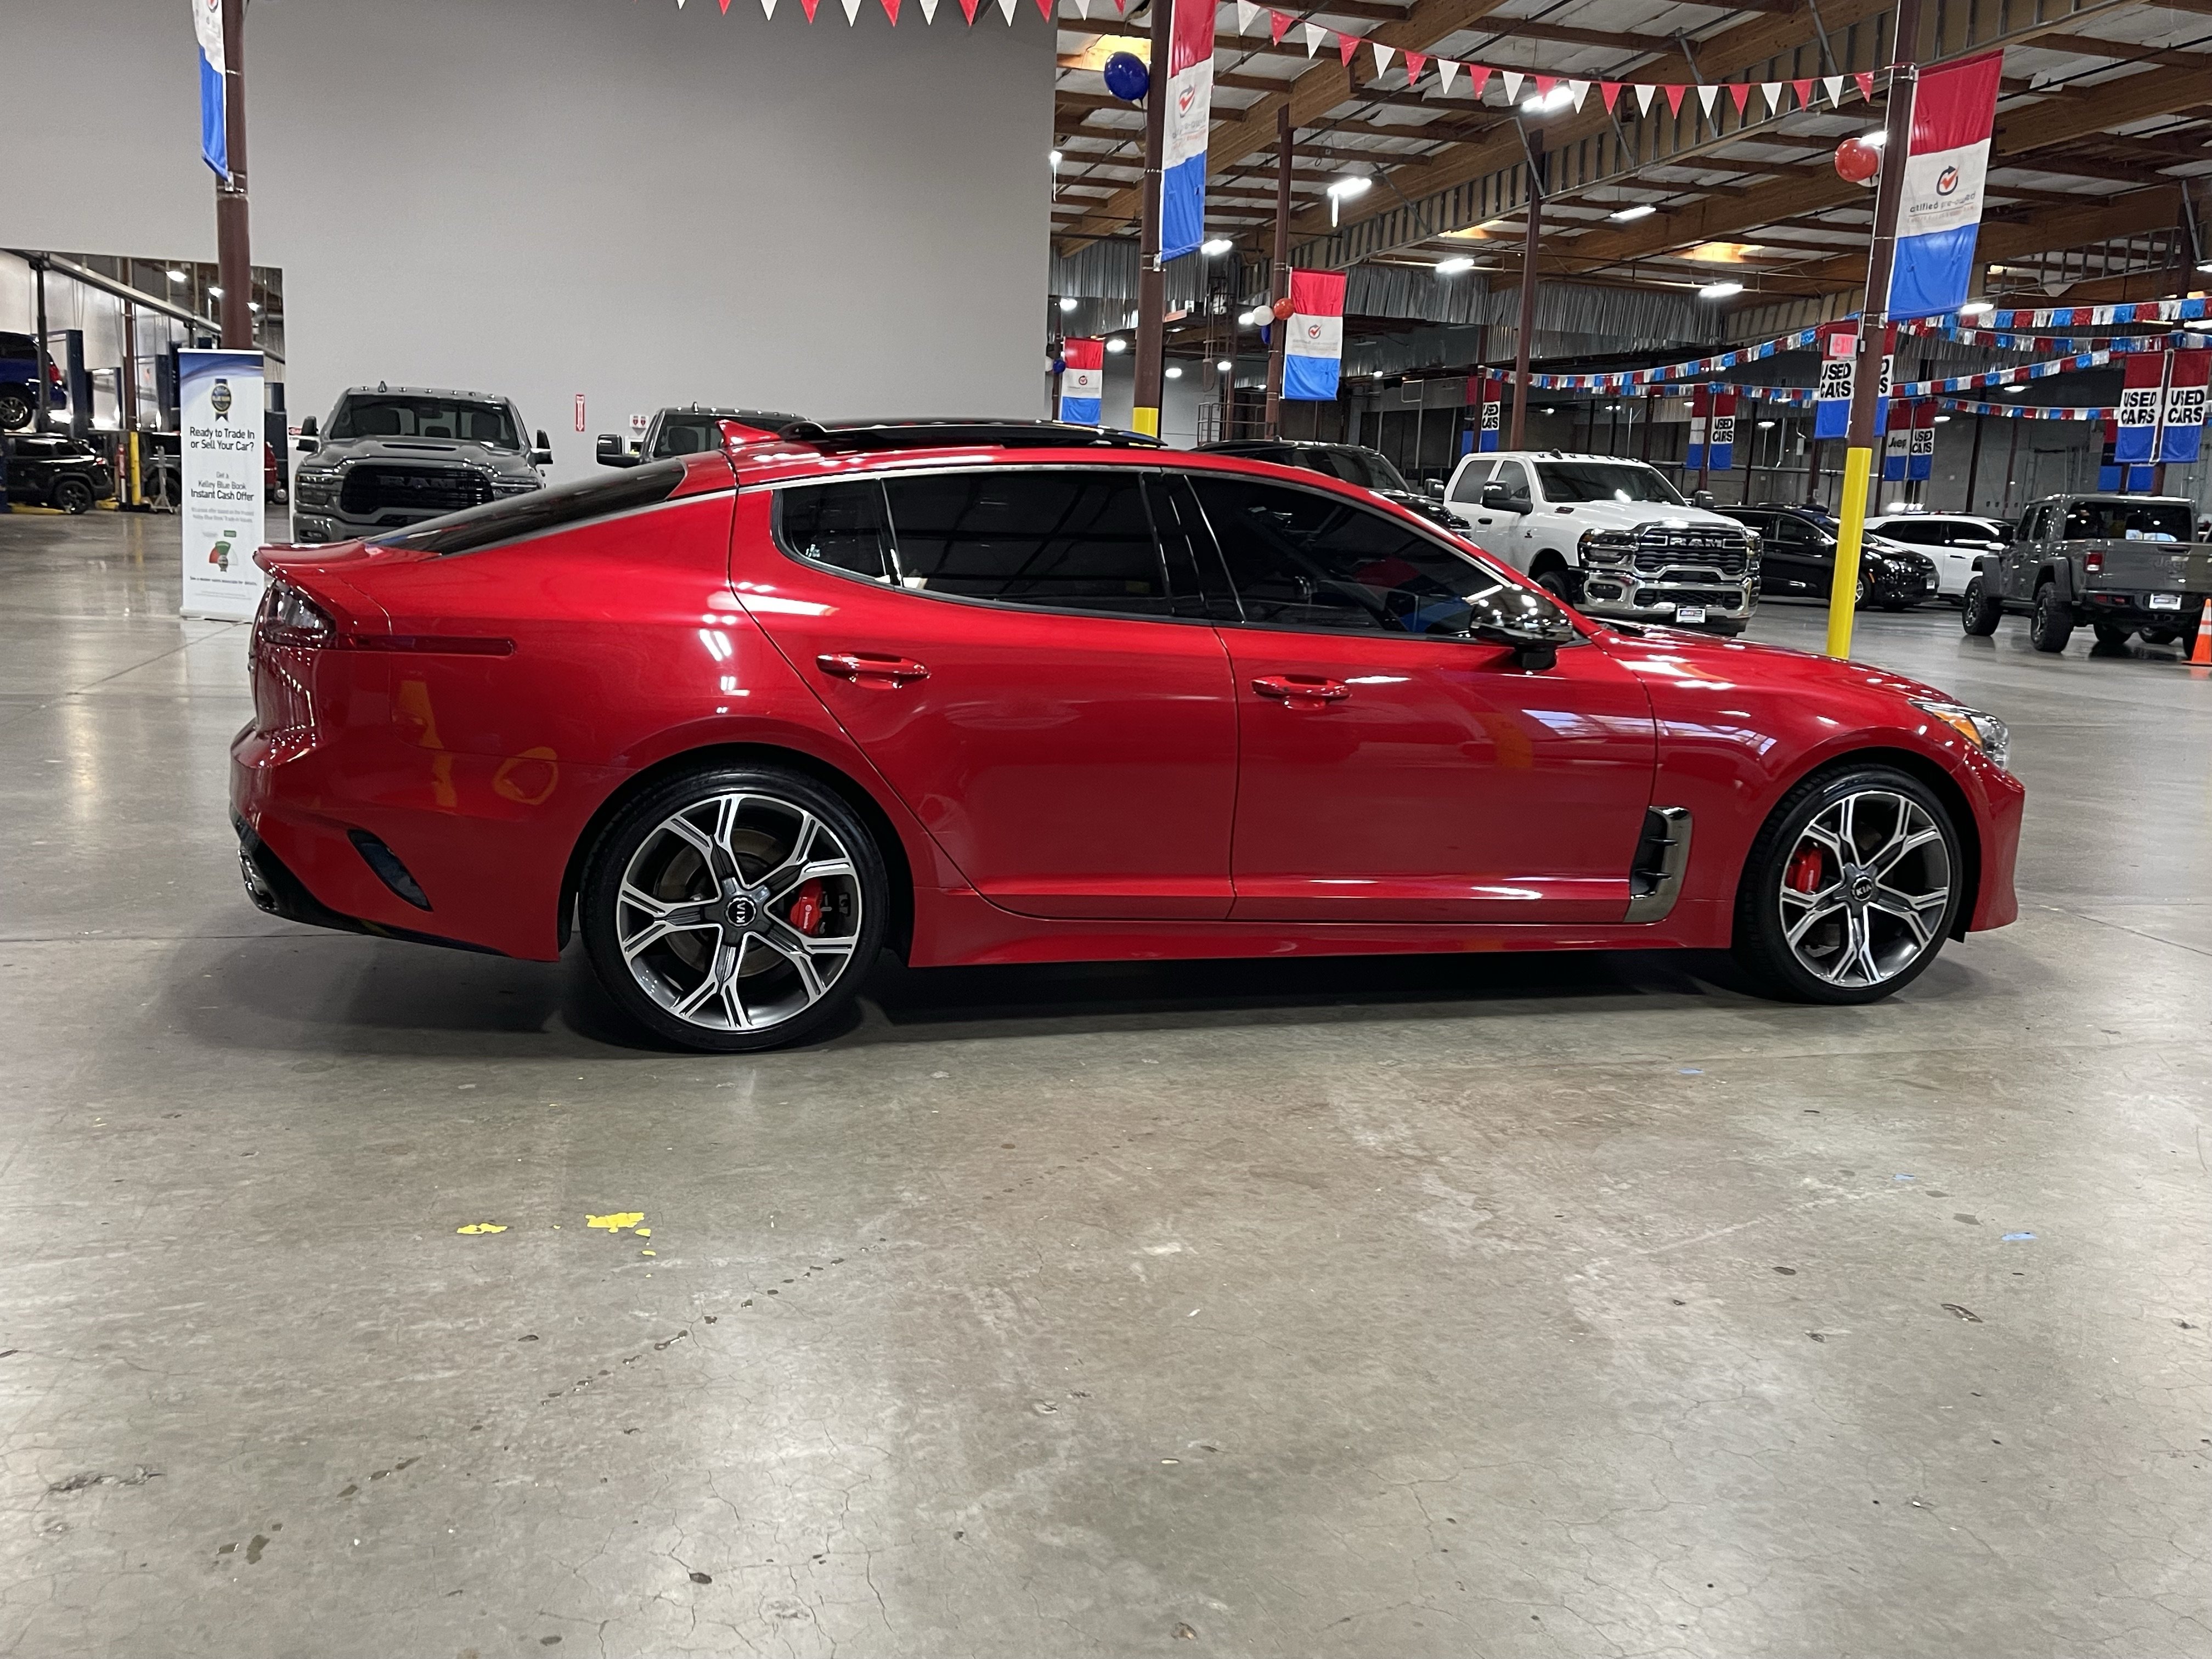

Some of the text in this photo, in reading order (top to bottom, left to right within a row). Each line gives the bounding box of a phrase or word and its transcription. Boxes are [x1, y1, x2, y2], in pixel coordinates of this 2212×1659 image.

[2124, 392, 2157, 407] USED
[2121, 408, 2155, 425] CARS
[2168, 407, 2203, 423] CARS
[1714, 419, 1733, 430] USED
[190, 426, 255, 439] Ready to Trade In
[1915, 430, 1933, 442] USED
[201, 439, 216, 449] Sell
[217, 440, 234, 450] Your
[236, 441, 254, 452] Car?
[217, 481, 230, 489] Blue
[232, 481, 246, 489] Book
[191, 488, 254, 501] Instant Cash Offer
[1669, 537, 1722, 547] RAM
[1857, 884, 1872, 896] KIA
[736, 902, 746, 923] KIA
